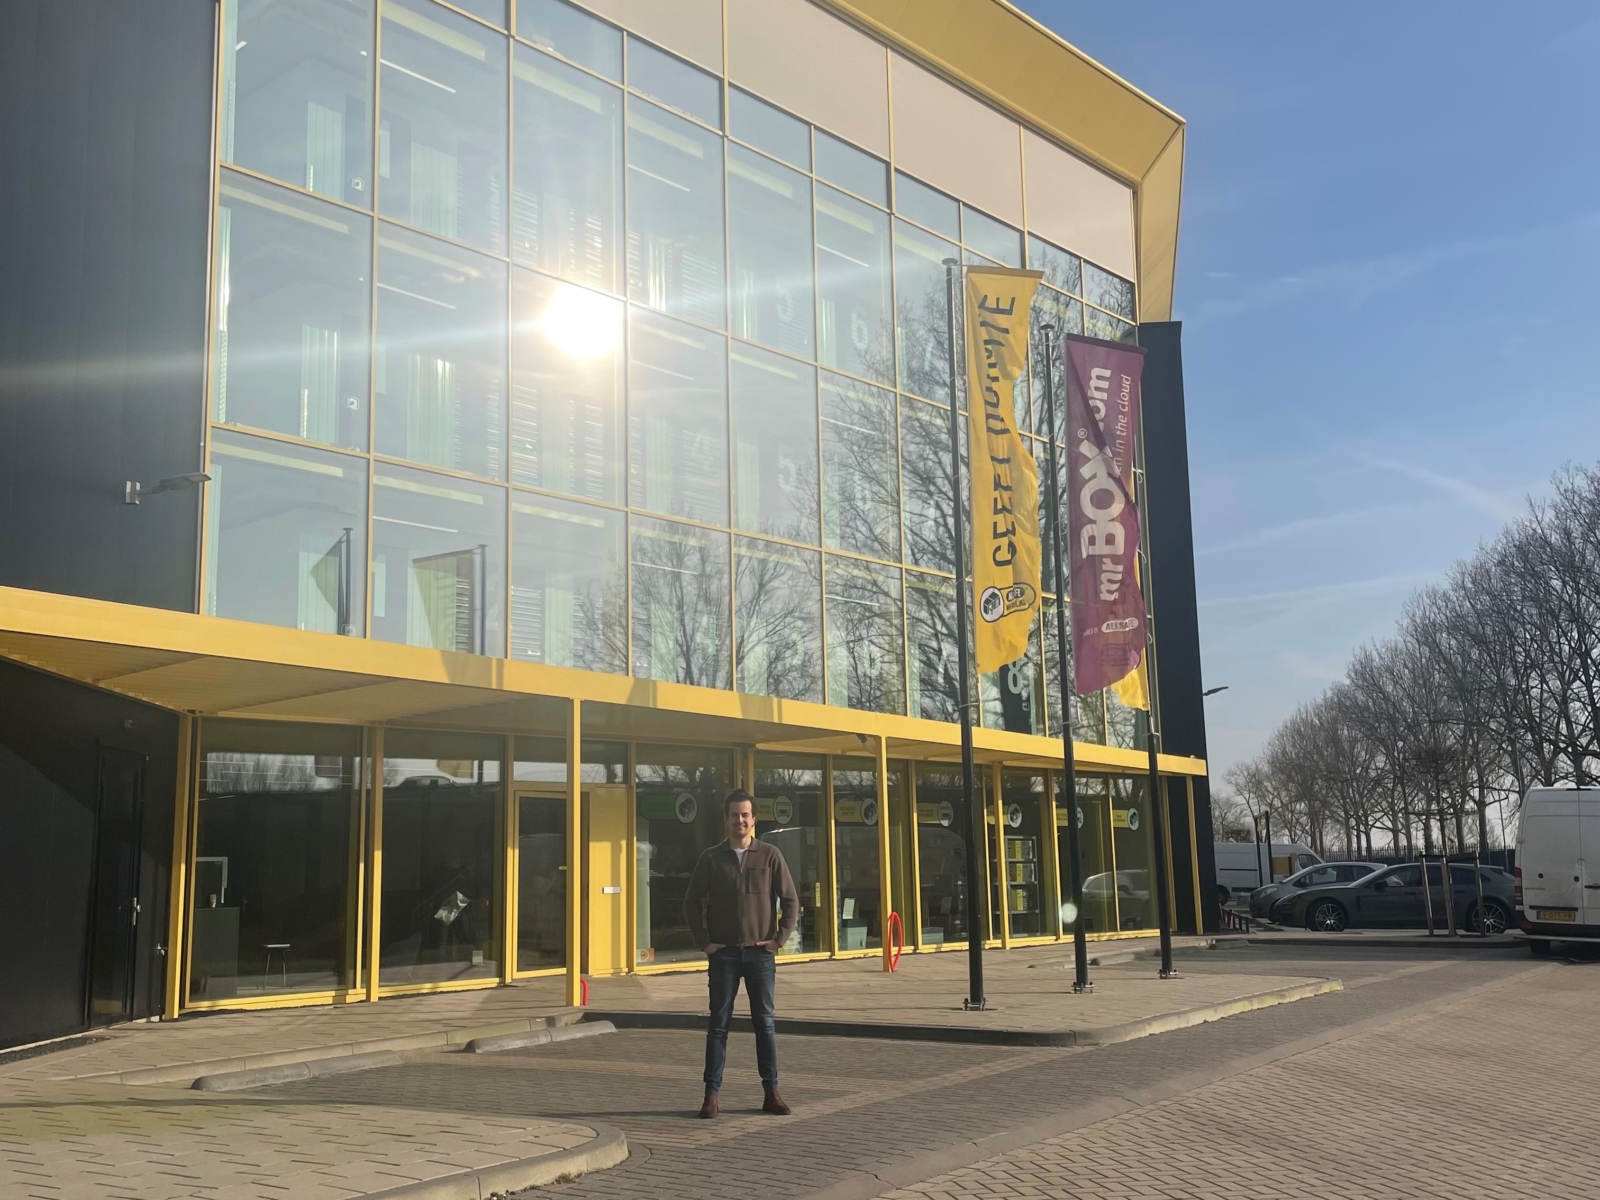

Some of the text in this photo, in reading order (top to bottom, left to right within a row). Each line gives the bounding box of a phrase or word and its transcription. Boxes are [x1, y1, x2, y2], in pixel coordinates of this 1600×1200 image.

[851, 304, 869, 350] 6
[1118, 374, 1132, 412] cloud
[1114, 415, 1128, 436] the
[778, 444, 796, 492] 5
[1007, 660, 1022, 695] 8
